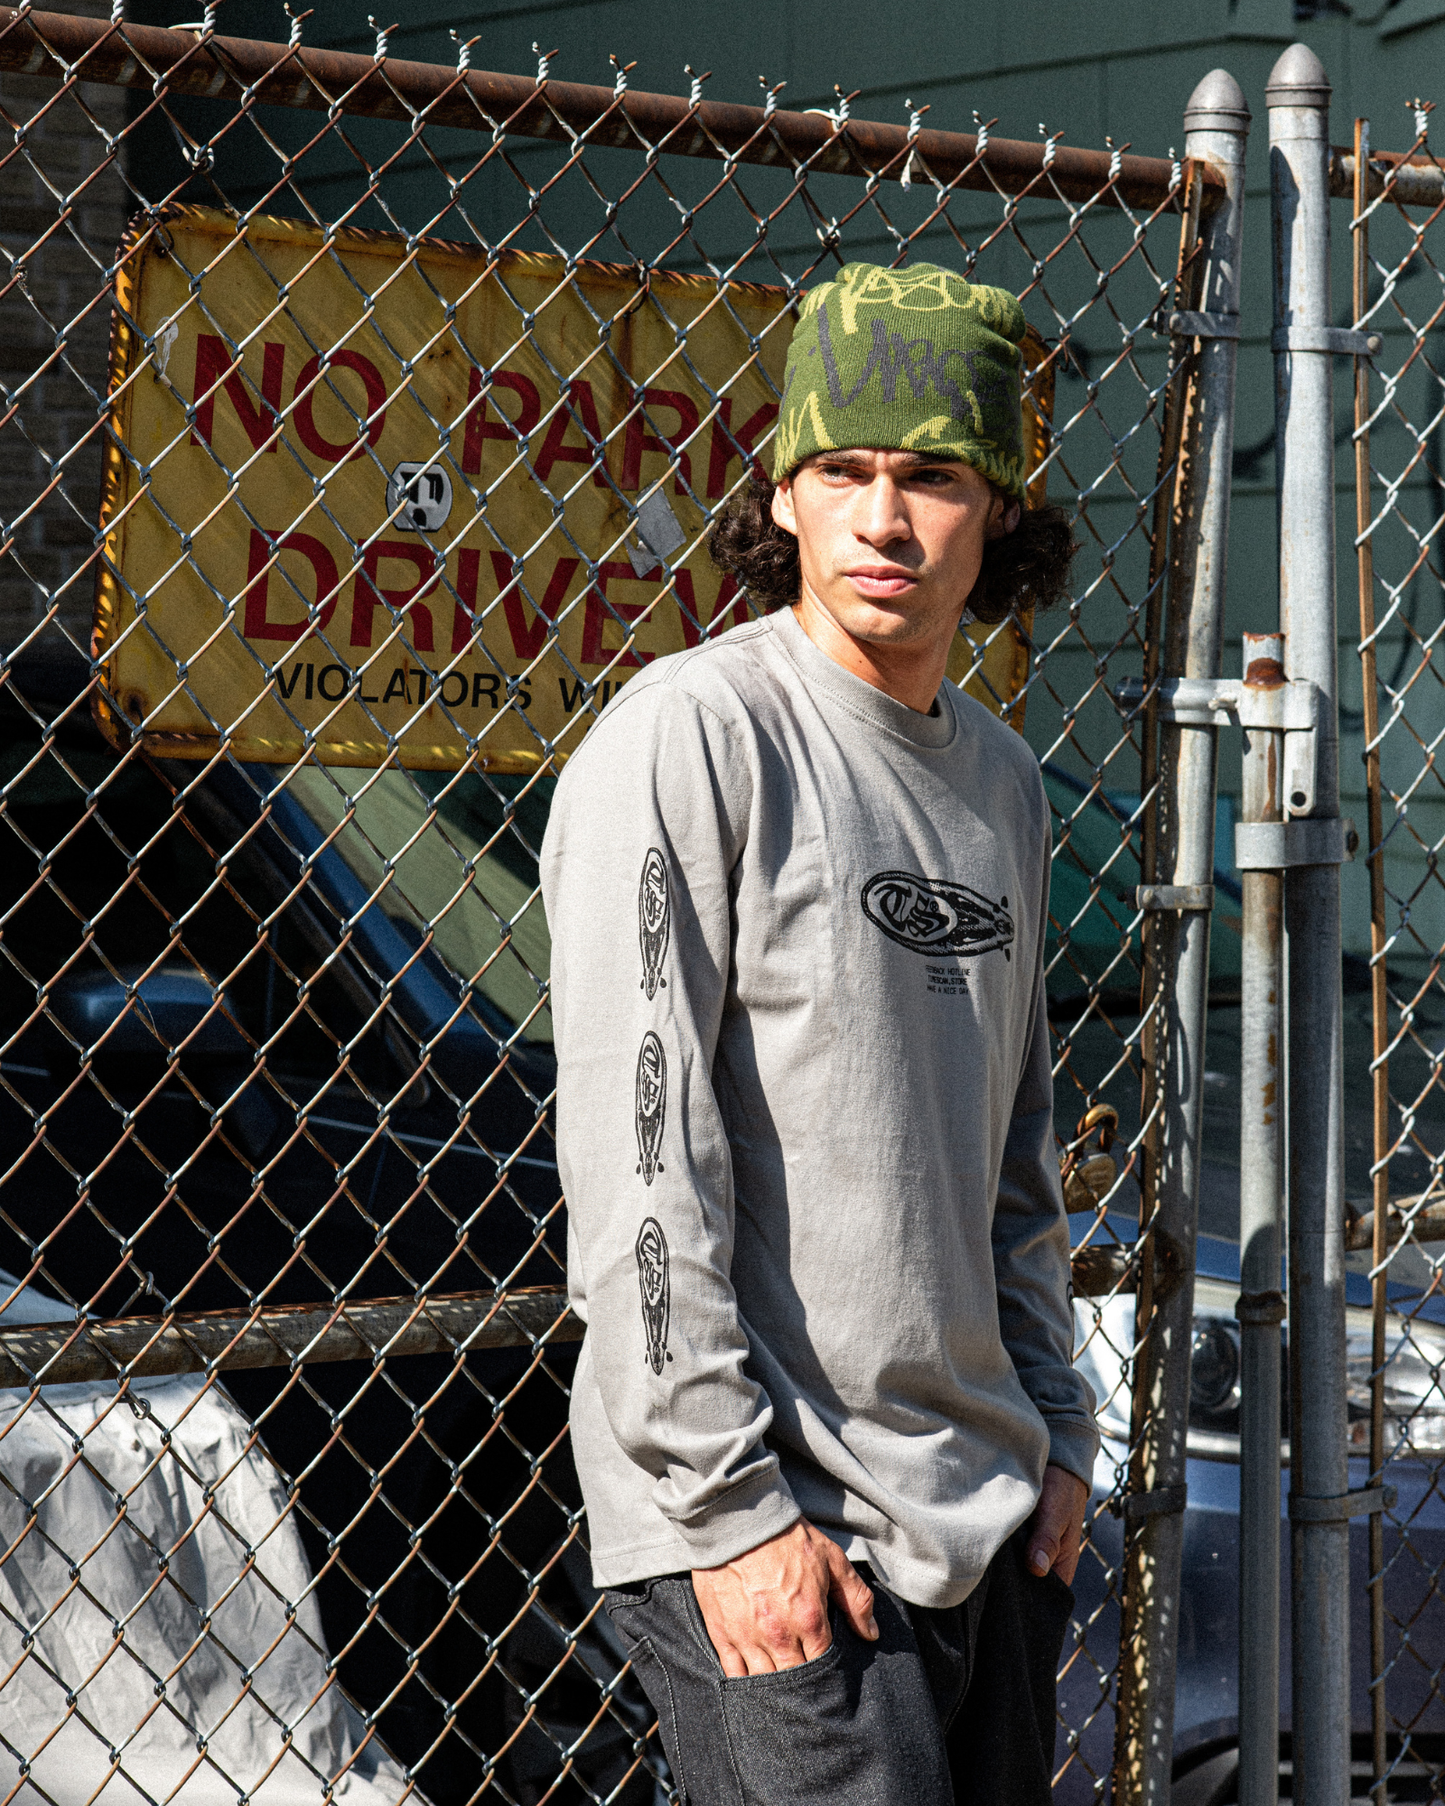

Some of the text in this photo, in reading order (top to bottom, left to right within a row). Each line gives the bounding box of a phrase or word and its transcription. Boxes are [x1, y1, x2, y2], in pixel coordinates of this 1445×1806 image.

[190, 332, 387, 462] NO
[273, 662, 533, 710] VIOLATORS
[948, 967, 971, 976] HOTLINE
[943, 986, 957, 995] NICE
[959, 986, 969, 995] DAY
